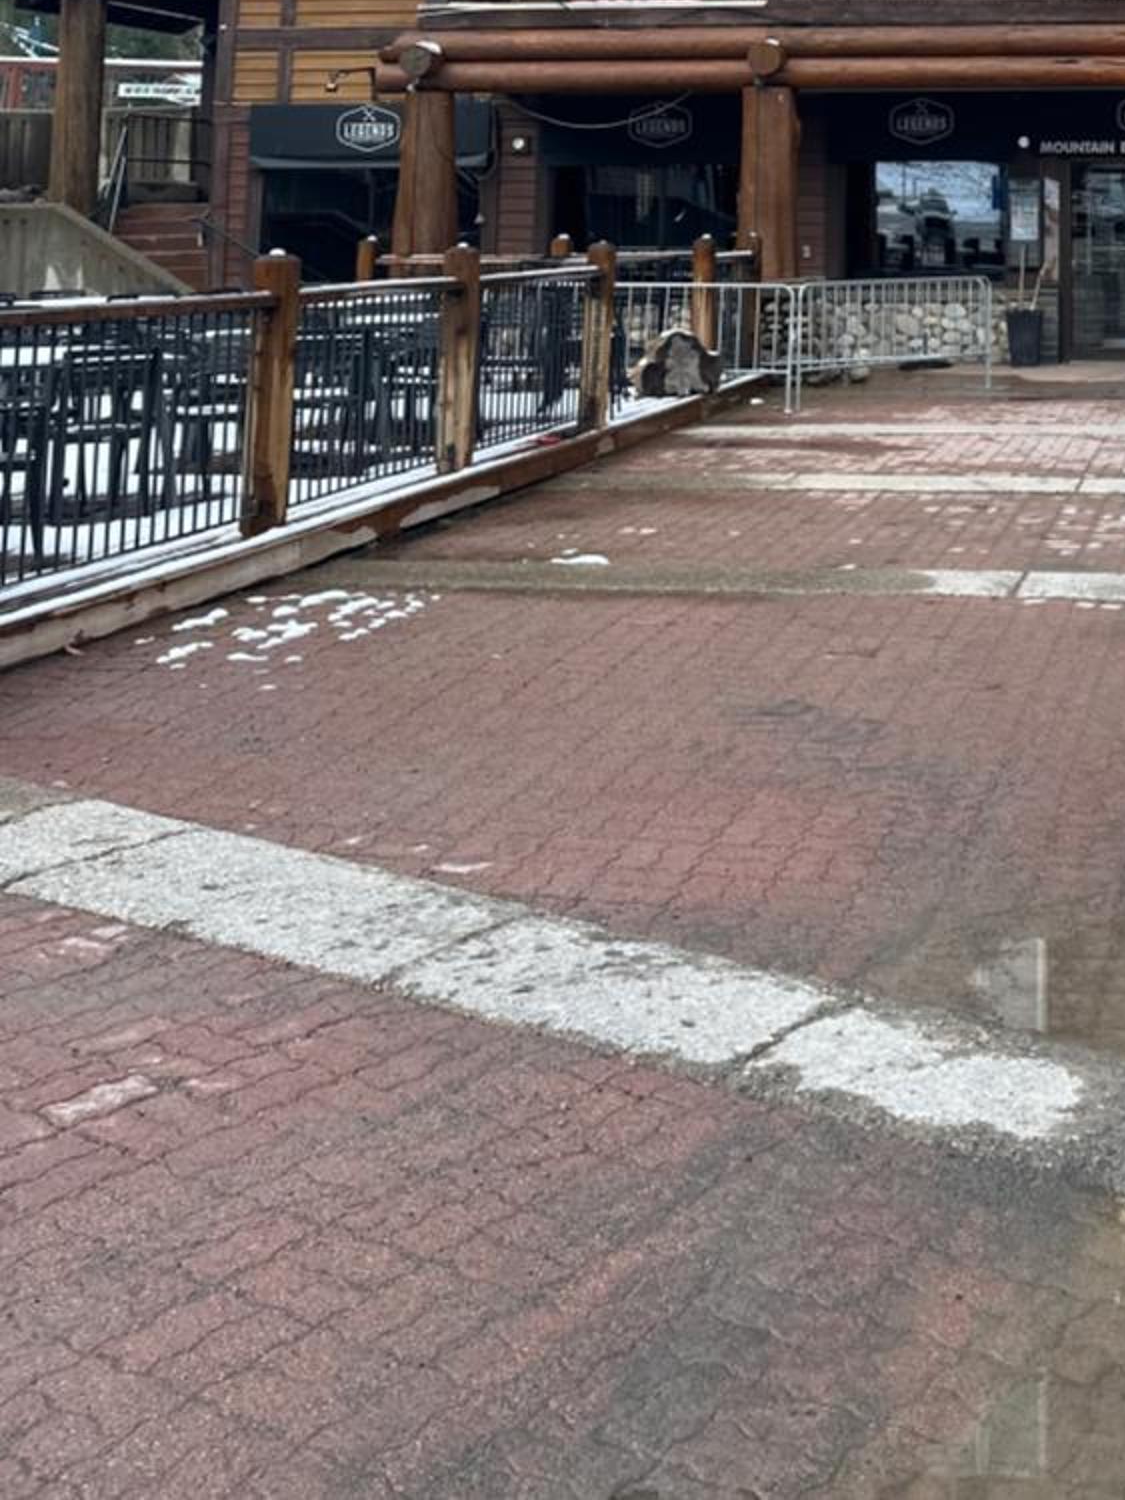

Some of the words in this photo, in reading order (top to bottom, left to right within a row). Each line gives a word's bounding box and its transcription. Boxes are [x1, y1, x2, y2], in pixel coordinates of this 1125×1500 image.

[343, 121, 395, 138] LEGENDS
[896, 114, 947, 132] LEGENDS
[1039, 140, 1115, 155] MOUNTAIN
